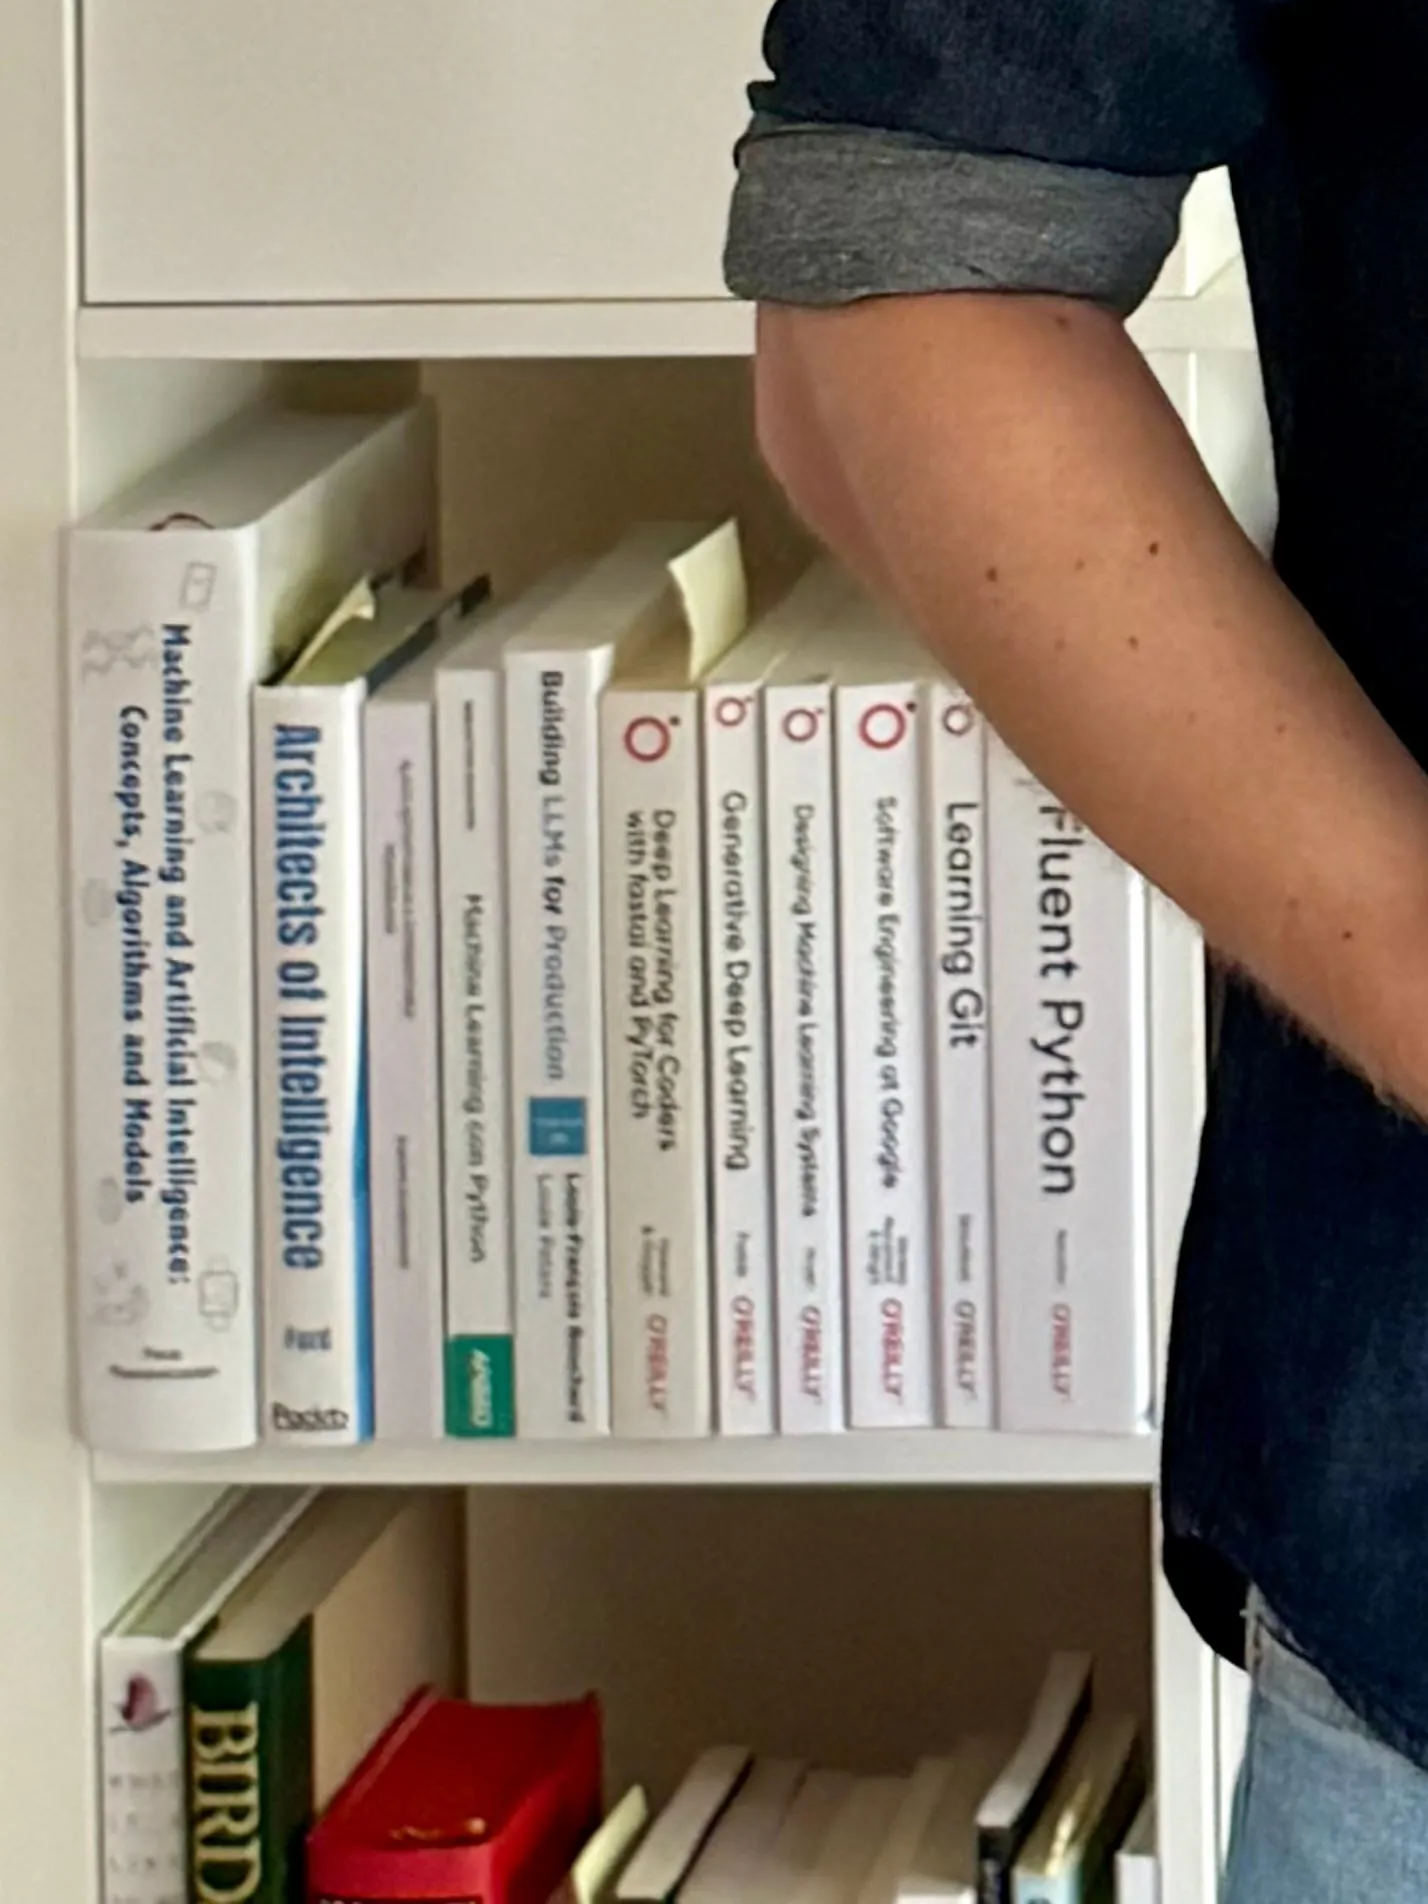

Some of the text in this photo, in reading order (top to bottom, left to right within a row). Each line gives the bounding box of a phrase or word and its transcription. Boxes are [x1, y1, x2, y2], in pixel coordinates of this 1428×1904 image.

[536, 671, 571, 1082] Building LLMs for Production
[788, 804, 818, 915] Designing
[874, 796, 901, 907] Software
[115, 706, 155, 1203] Concepts, Algorithms and Models
[158, 623, 199, 1286] Machine Learning and Artificial Intelligence:
[459, 894, 488, 994] Machine
[623, 810, 655, 1119] with fastai and PyTorch
[647, 809, 682, 1152] Deep Learning for Coders
[719, 792, 755, 1172] Generative Deep Learning
[795, 921, 819, 1016] Machine
[871, 914, 903, 1058] Engineering
[940, 803, 984, 1049] Learning Git
[271, 723, 338, 1269] Architects of Intelligence
[458, 1004, 489, 1112] Learning
[792, 1023, 821, 1122] Learning
[879, 1065, 903, 1091] at
[1020, 1000, 1086, 1195] Python
[793, 1128, 823, 1219] Systems
[874, 1099, 905, 1190] Google
[458, 1175, 491, 1264] Python
